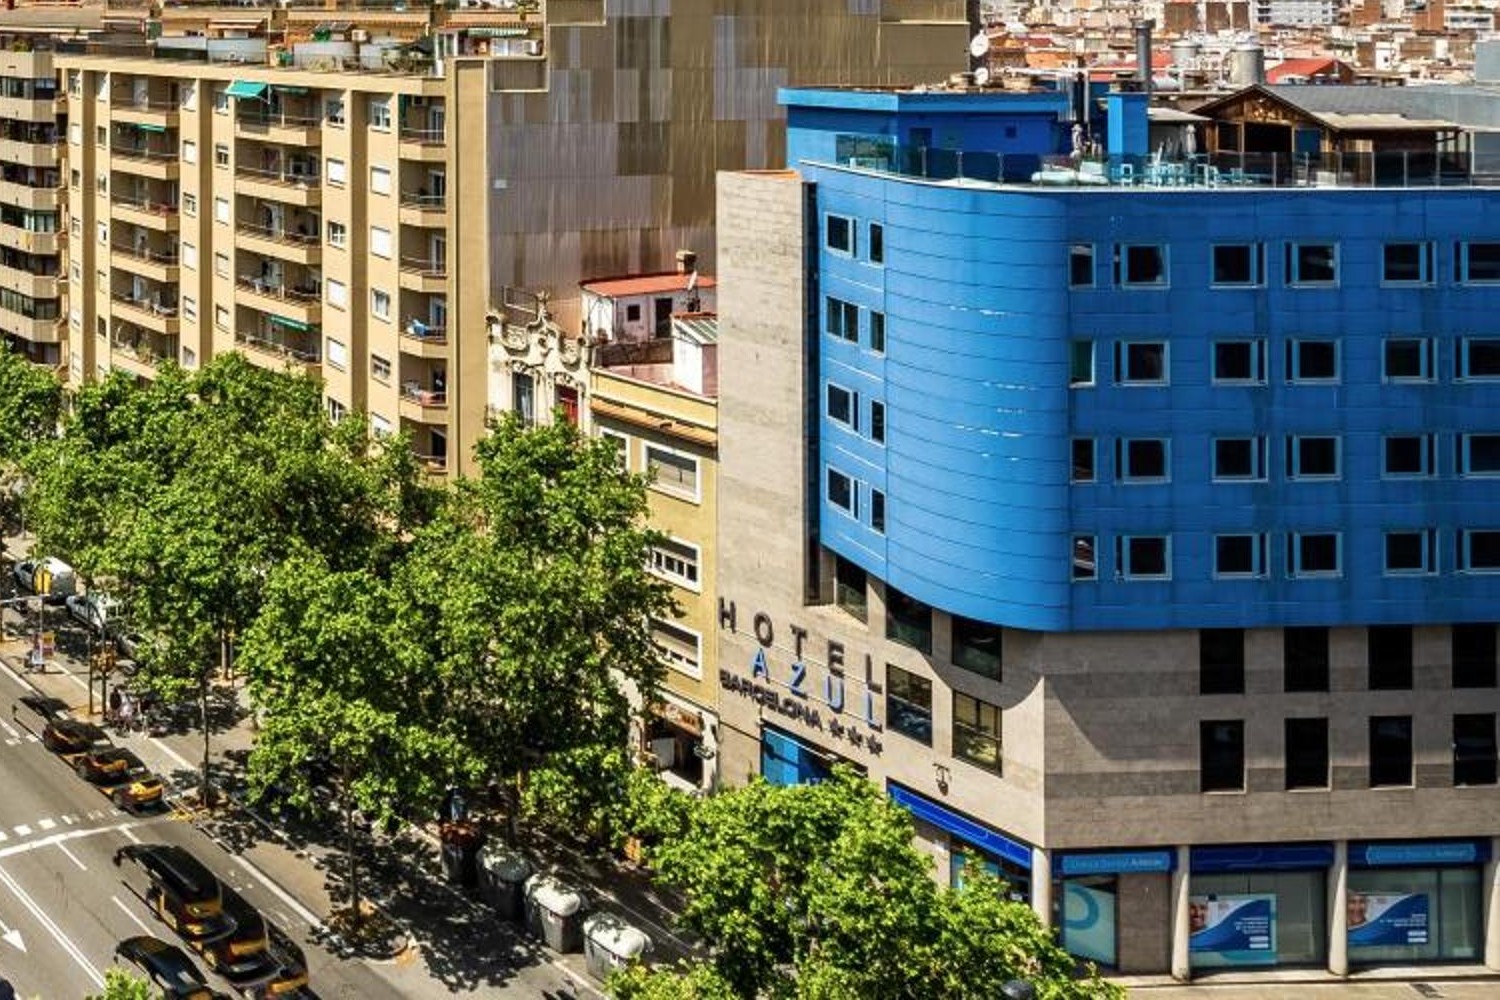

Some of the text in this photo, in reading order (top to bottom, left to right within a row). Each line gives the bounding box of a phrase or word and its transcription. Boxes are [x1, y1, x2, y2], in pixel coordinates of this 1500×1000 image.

[719, 597, 882, 695] HOTEL
[719, 669, 823, 732] BARCELONA
[752, 648, 883, 733] AZUL
